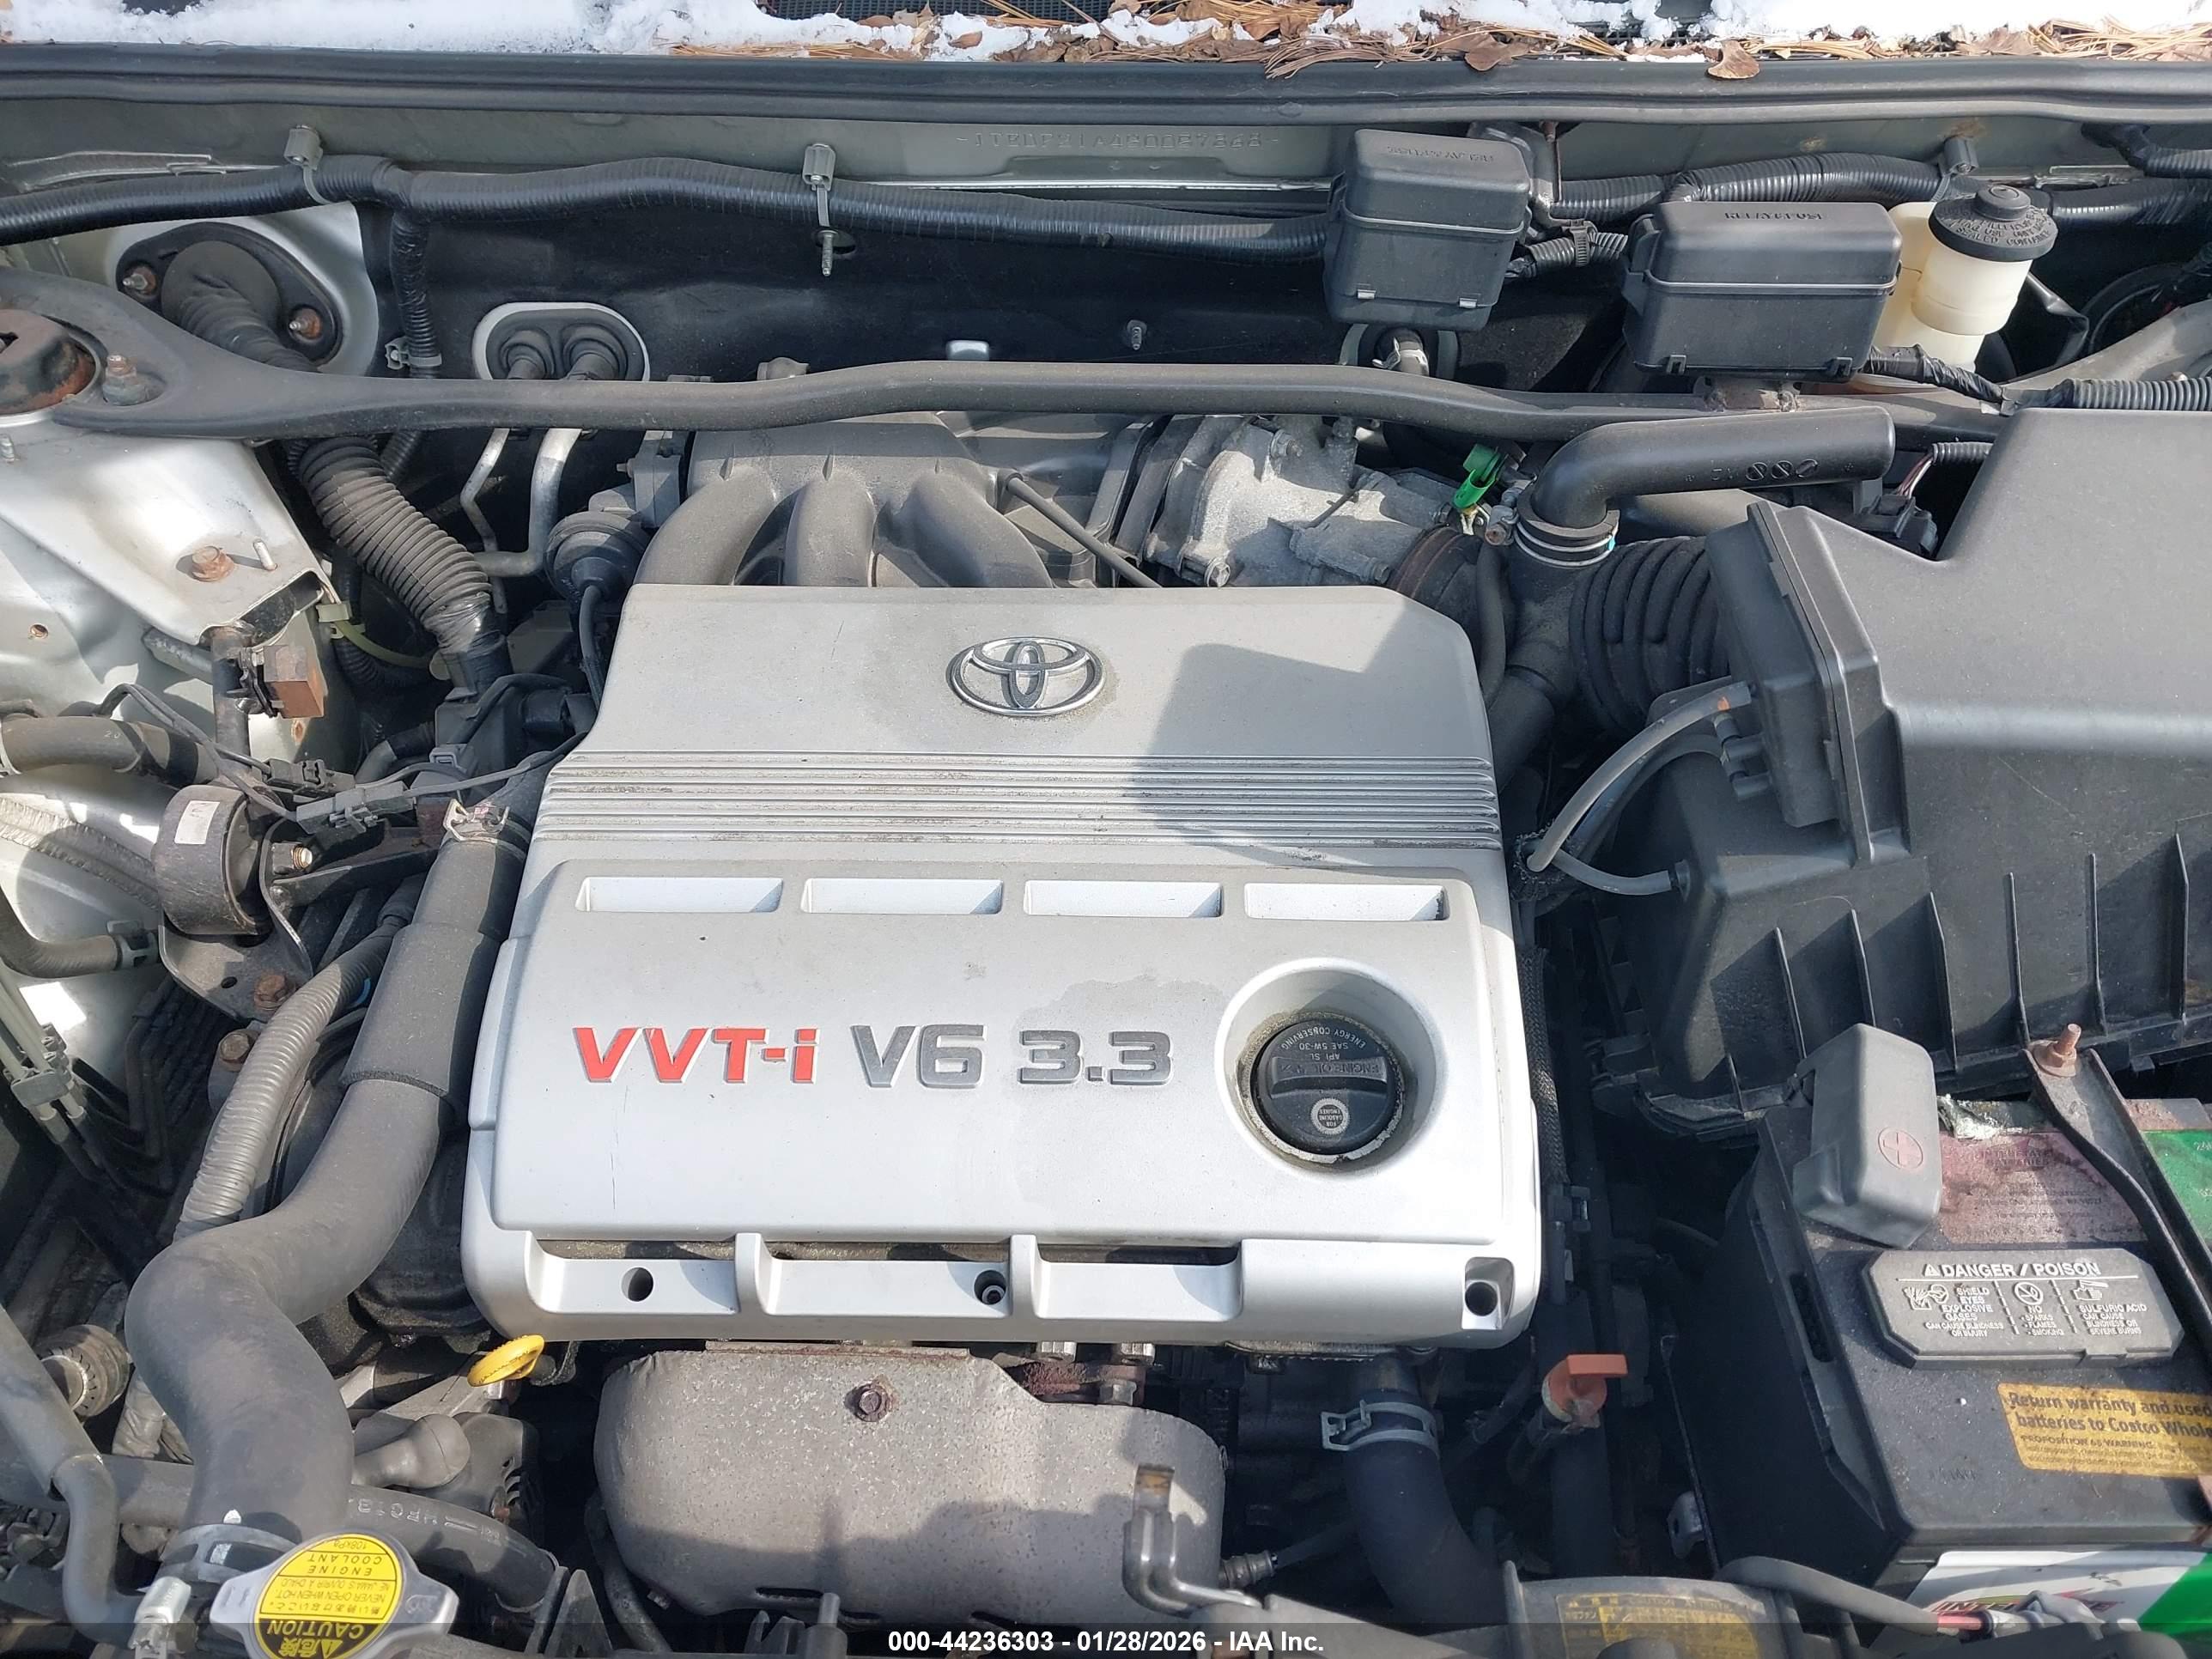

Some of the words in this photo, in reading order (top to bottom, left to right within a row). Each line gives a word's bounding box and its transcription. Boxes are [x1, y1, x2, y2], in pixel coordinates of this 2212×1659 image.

[1281, 1027, 1331, 1049] CONSERVING
[1334, 1029, 1366, 1048] ENERGY
[572, 1026, 820, 1085] VVT-i
[851, 1024, 988, 1090] V6
[1017, 1029, 1175, 1086] 3.3
[1942, 1264, 2014, 1277] DANGER
[2035, 1262, 2101, 1276] POISON
[1956, 1286, 1990, 1295] SHIELD
[1960, 1296, 1985, 1304] EYES
[1942, 1304, 1993, 1313] EXPLOSIVE
[2008, 1392, 2063, 1408] Return
[2067, 1395, 2136, 1416] warranty
[2141, 1401, 2171, 1414] and
[2015, 1413, 2086, 1431] batteries
[2088, 1418, 2106, 1431] to
[2108, 1418, 2160, 1434] Costco
[307, 1553, 382, 1565] COOLANT
[307, 1565, 373, 1577] ENGINE
[296, 1590, 325, 1601] WHEN
[325, 1591, 352, 1602] OPEN
[355, 1592, 386, 1603] NEVER
[267, 1620, 365, 1639] CAUTION
